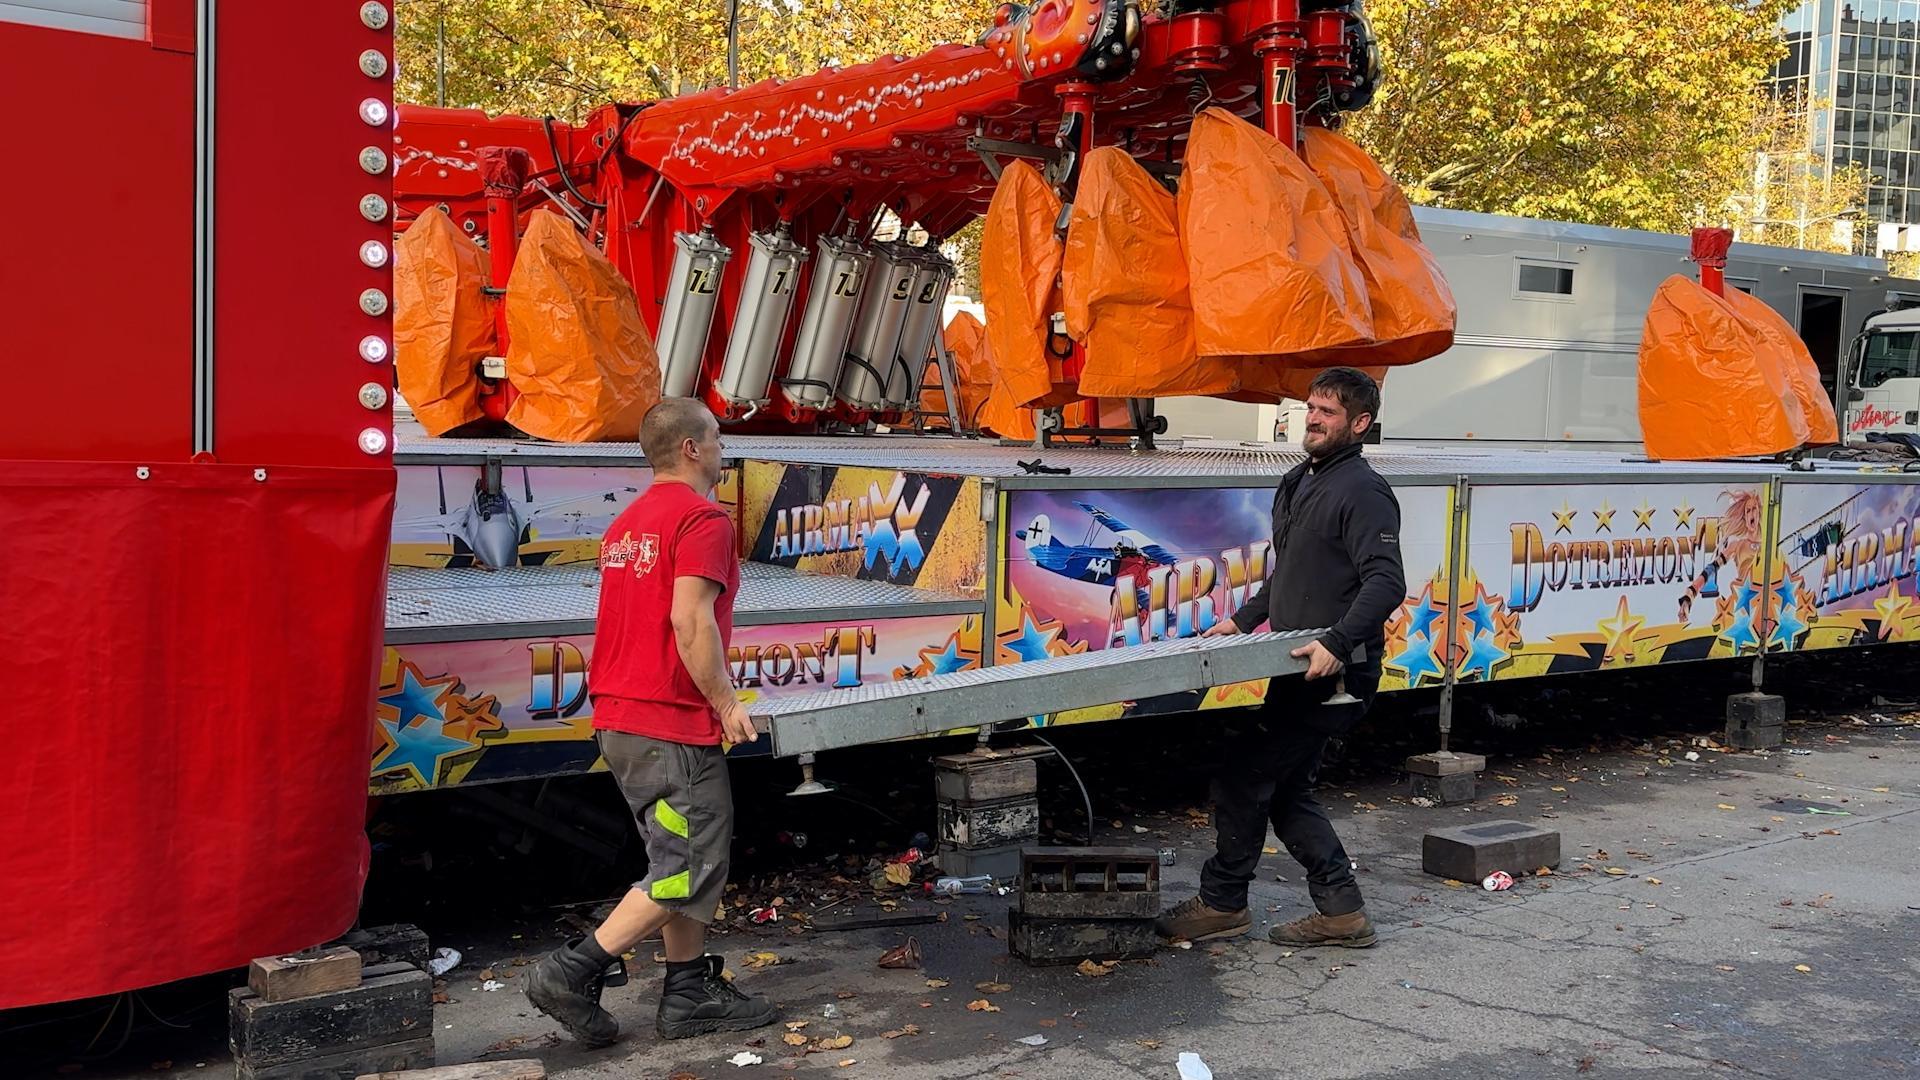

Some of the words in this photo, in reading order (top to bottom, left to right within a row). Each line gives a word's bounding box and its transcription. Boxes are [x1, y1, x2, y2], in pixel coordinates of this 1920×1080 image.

[770, 470, 931, 578] AIRMAXX
[1507, 516, 1725, 613] DOTREMONT
[1815, 516, 1920, 608] AIRMA
[1104, 539, 1271, 649] AIRM
[526, 625, 876, 719] DMONT
